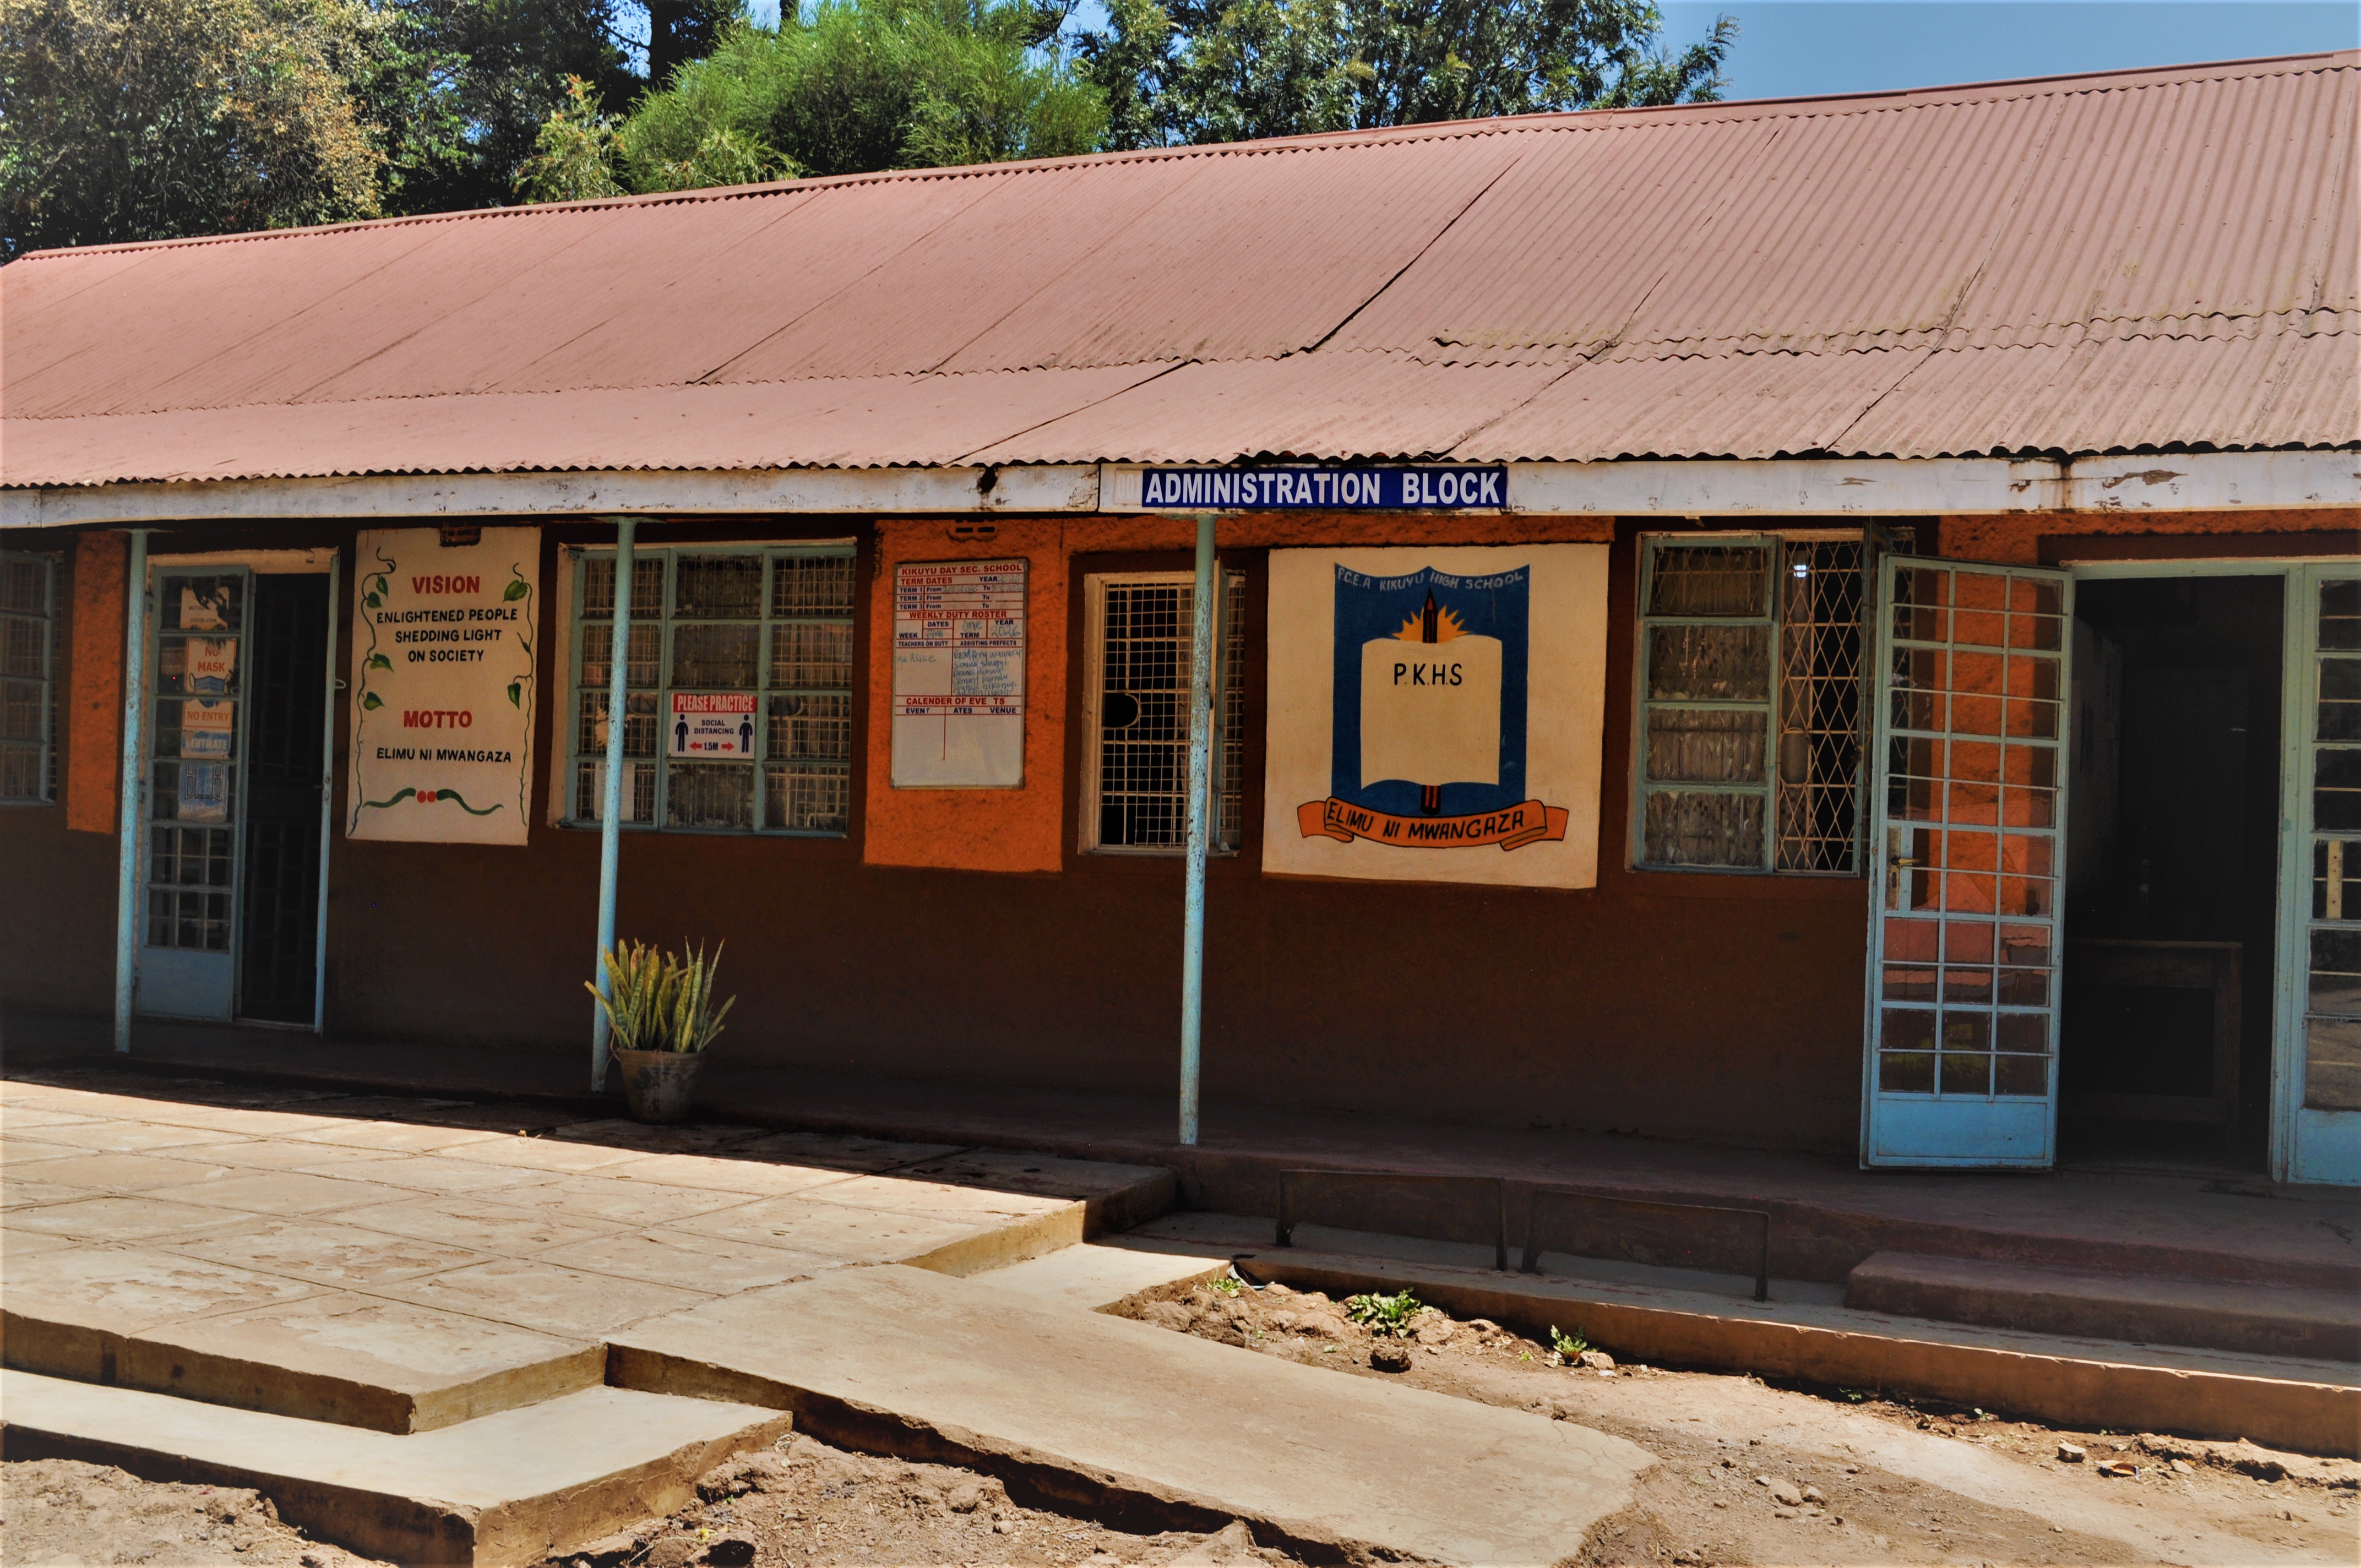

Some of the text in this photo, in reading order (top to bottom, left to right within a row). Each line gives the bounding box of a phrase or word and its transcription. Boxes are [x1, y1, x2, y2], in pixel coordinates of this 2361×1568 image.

[1145, 472, 1500, 504] ADMINISTRATION BLOCK
[412, 575, 480, 594] VISION
[1379, 573, 1424, 591] KIKUYU
[1429, 571, 1459, 589] HIGH
[1465, 573, 1523, 590] SCHOOL
[377, 609, 518, 623] ENLIGHTENED PEOPLE
[395, 629, 502, 643] SHEDDING LIGHT
[409, 650, 484, 662] ON SOCIETY
[198, 662, 225, 672] MASK
[678, 695, 753, 711] PLEASE PRACTICE
[188, 711, 229, 721] NO ENTRY
[404, 710, 472, 728] MOTTO
[704, 742, 719, 750] 1.5M
[377, 748, 512, 763] ELIMU NI MWANGAZA
[1327, 802, 1524, 840] ELIMU NI MWANGAZA
